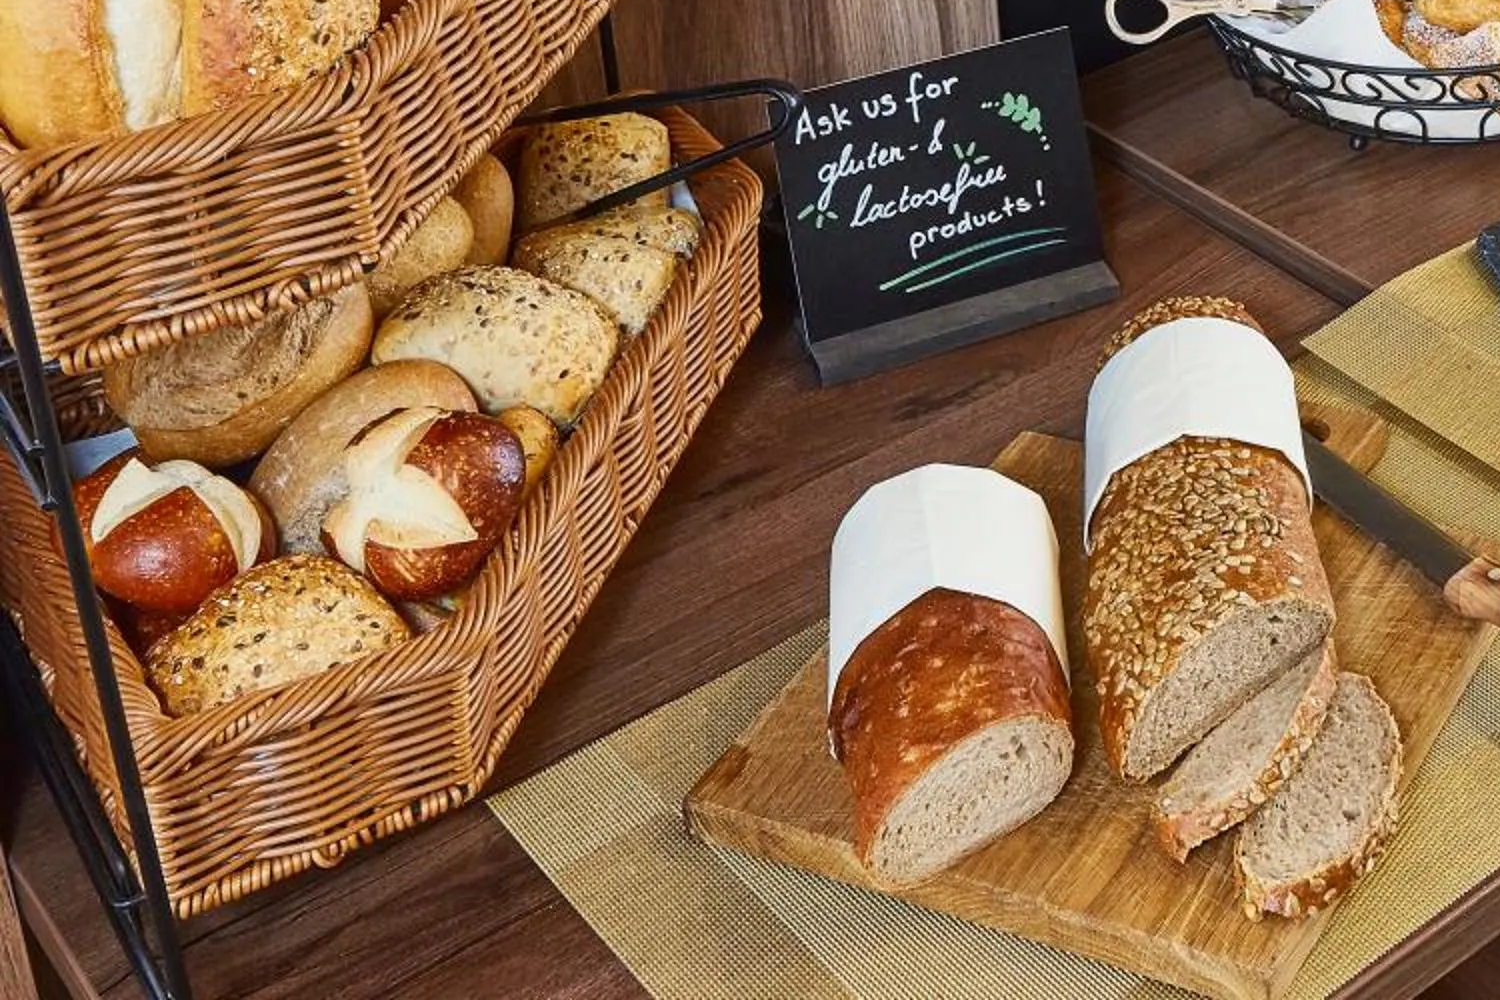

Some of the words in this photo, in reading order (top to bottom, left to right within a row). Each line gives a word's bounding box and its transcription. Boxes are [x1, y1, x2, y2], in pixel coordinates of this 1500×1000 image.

[795, 103, 852, 144] Ask
[862, 93, 897, 119] us
[905, 71, 959, 123] for
[908, 179, 1047, 259] products!
